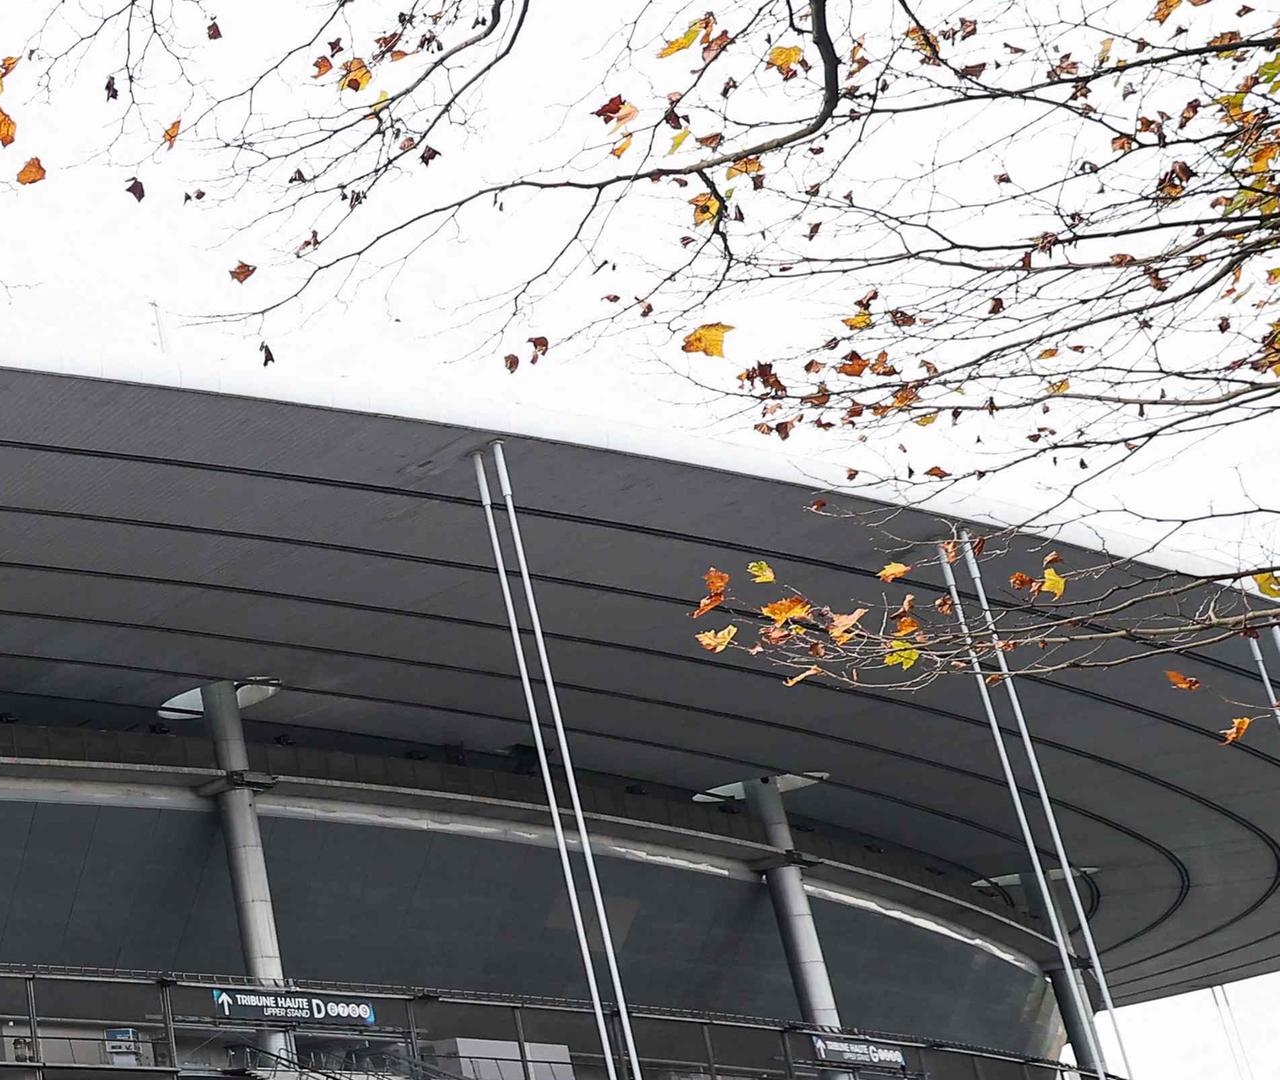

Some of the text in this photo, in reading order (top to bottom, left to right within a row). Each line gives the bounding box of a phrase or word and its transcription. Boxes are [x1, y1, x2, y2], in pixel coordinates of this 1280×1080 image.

[235, 994, 276, 1007] TRIBUNE
[278, 998, 310, 1009] HAUTE
[312, 999, 325, 1018] D
[263, 1007, 310, 1018] UPPER STAND
